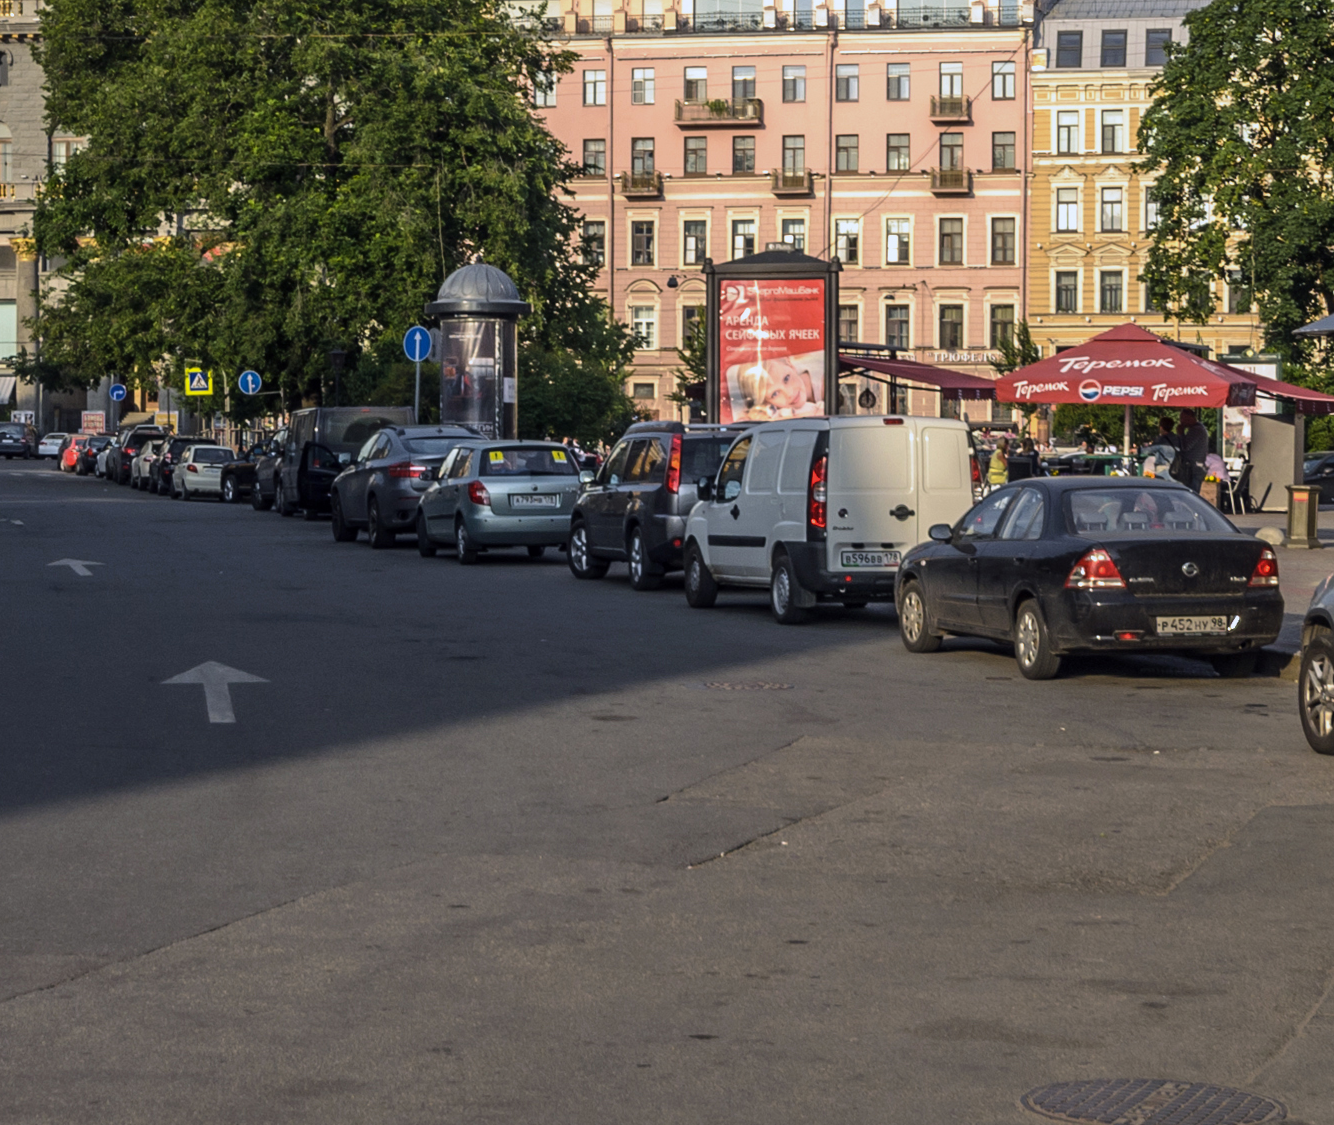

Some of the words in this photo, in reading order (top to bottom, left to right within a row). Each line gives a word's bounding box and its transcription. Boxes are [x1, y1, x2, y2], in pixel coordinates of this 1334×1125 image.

[725, 315, 769, 326] АРЕНДА
[788, 328, 820, 340] ЯЧЕЕК
[1058, 356, 1176, 374] Теремок
[1013, 380, 1070, 399] Теремок
[1102, 385, 1144, 397] PEPSI
[1151, 383, 1209, 402] Теремок
[846, 553, 883, 563] В596ВВ
[884, 553, 898, 563] 178
[1161, 618, 1209, 631] Р452НУ
[1211, 617, 1223, 627] 98
